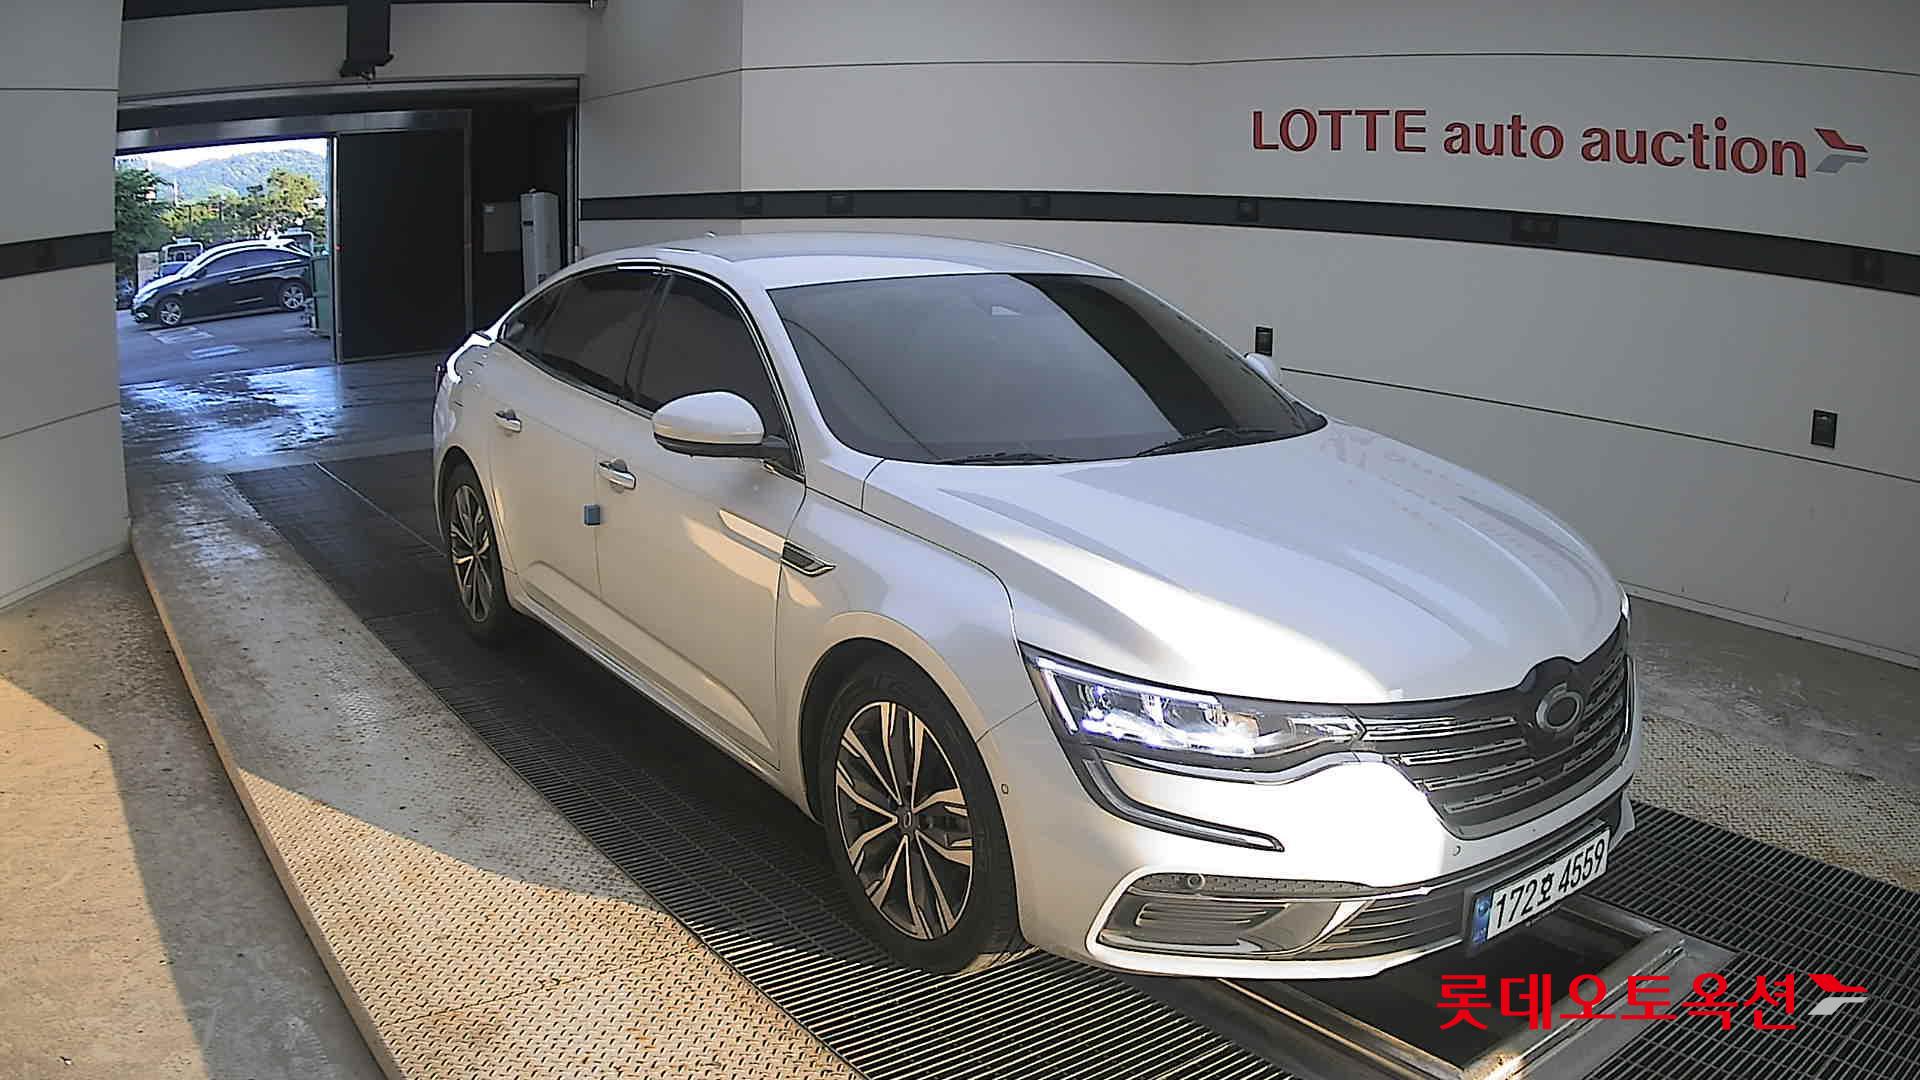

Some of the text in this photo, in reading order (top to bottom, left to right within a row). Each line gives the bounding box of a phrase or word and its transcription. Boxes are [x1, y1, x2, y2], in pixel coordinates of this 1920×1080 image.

[1252, 109, 1808, 178] LOTTE auto auction
[1495, 838, 1605, 929] 172호 4559
